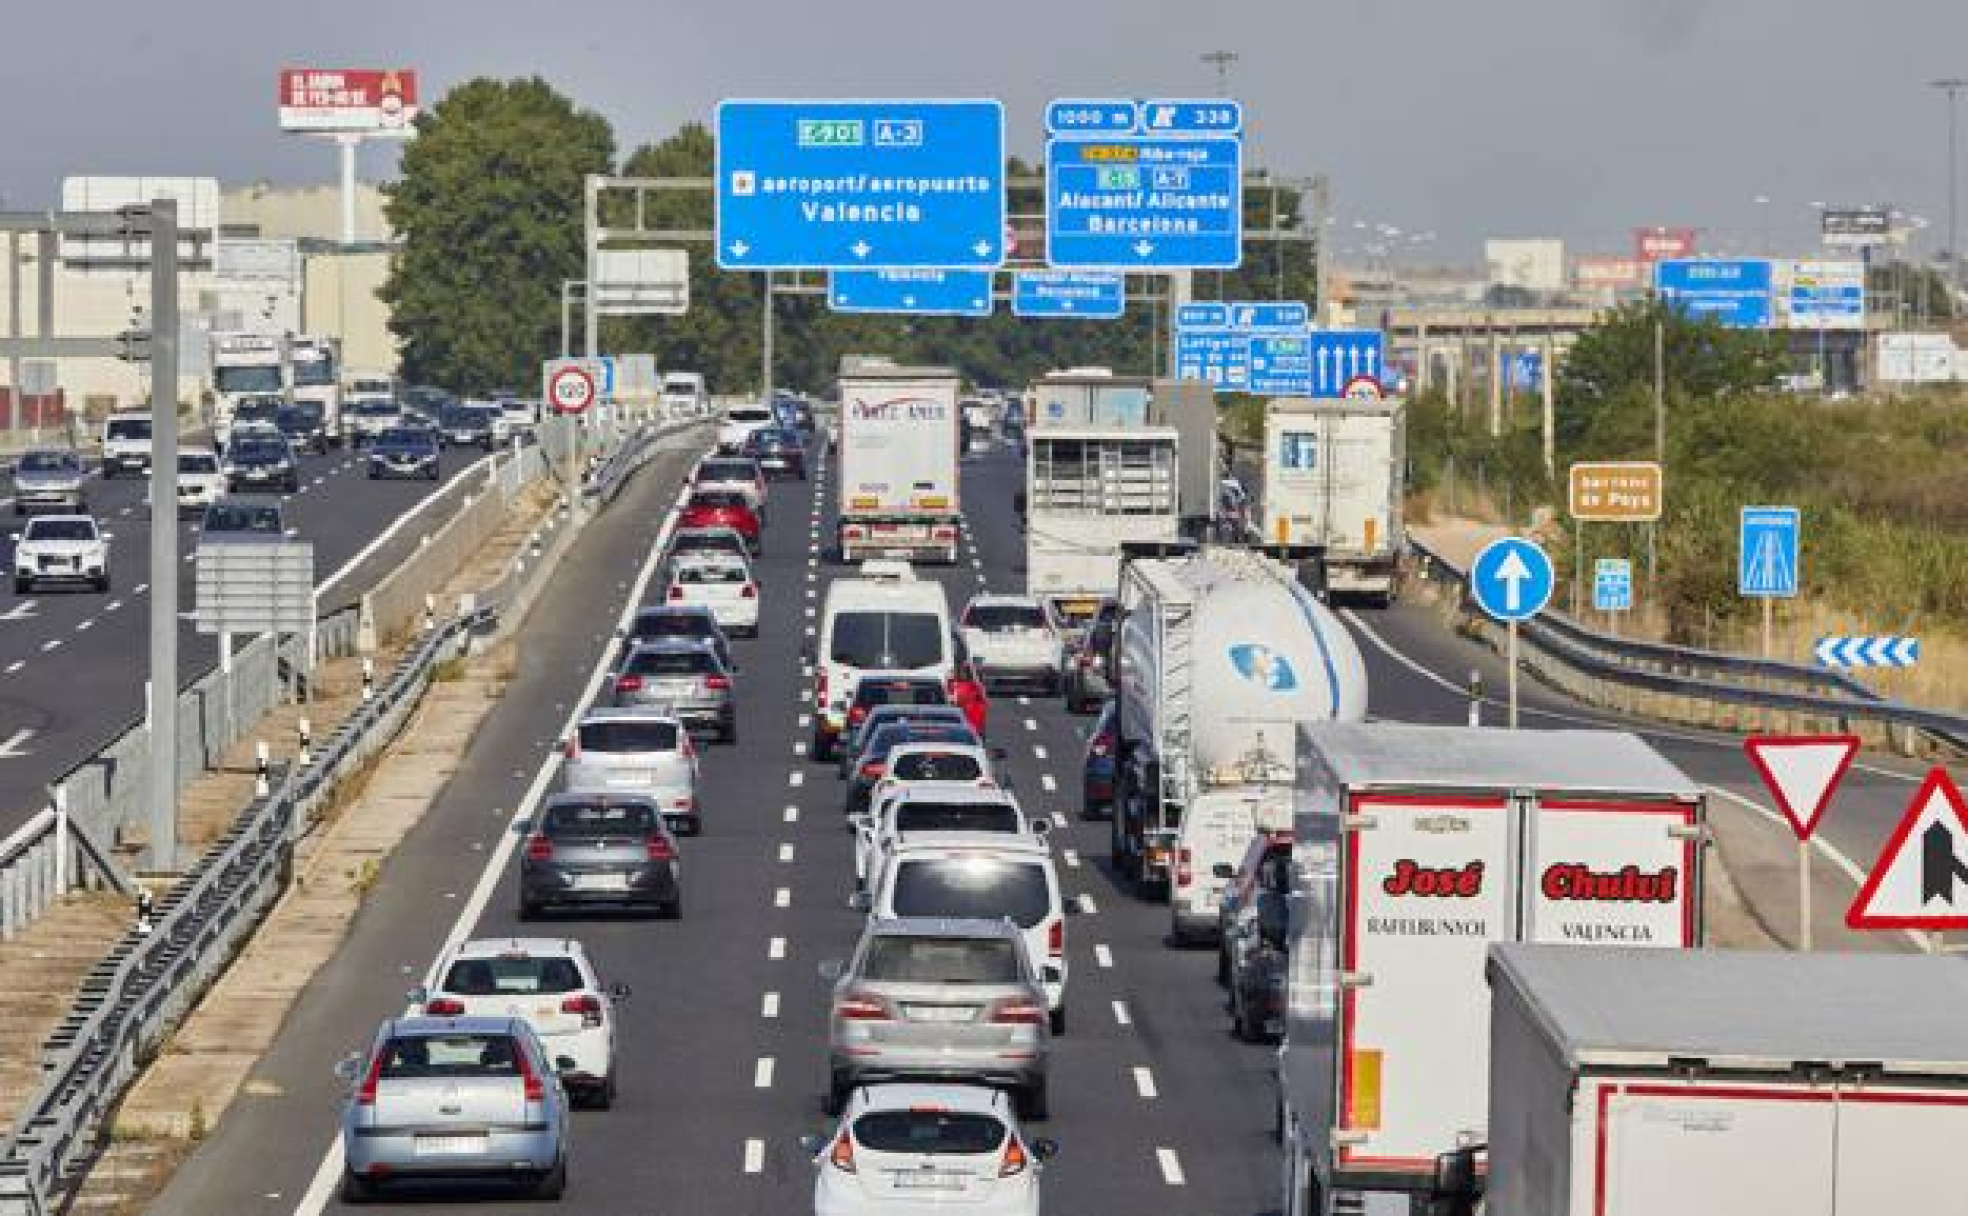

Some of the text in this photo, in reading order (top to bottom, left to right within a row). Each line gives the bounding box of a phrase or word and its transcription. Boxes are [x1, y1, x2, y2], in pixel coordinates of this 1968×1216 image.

[802, 124, 860, 143] E-901
[880, 124, 918, 143] A-3
[802, 202, 921, 222] Valencia
[1089, 215, 1198, 233] Barcelona
[559, 382, 585, 398] 120
[1382, 859, 1485, 898] José
[1562, 921, 1654, 942] VALENCIA
